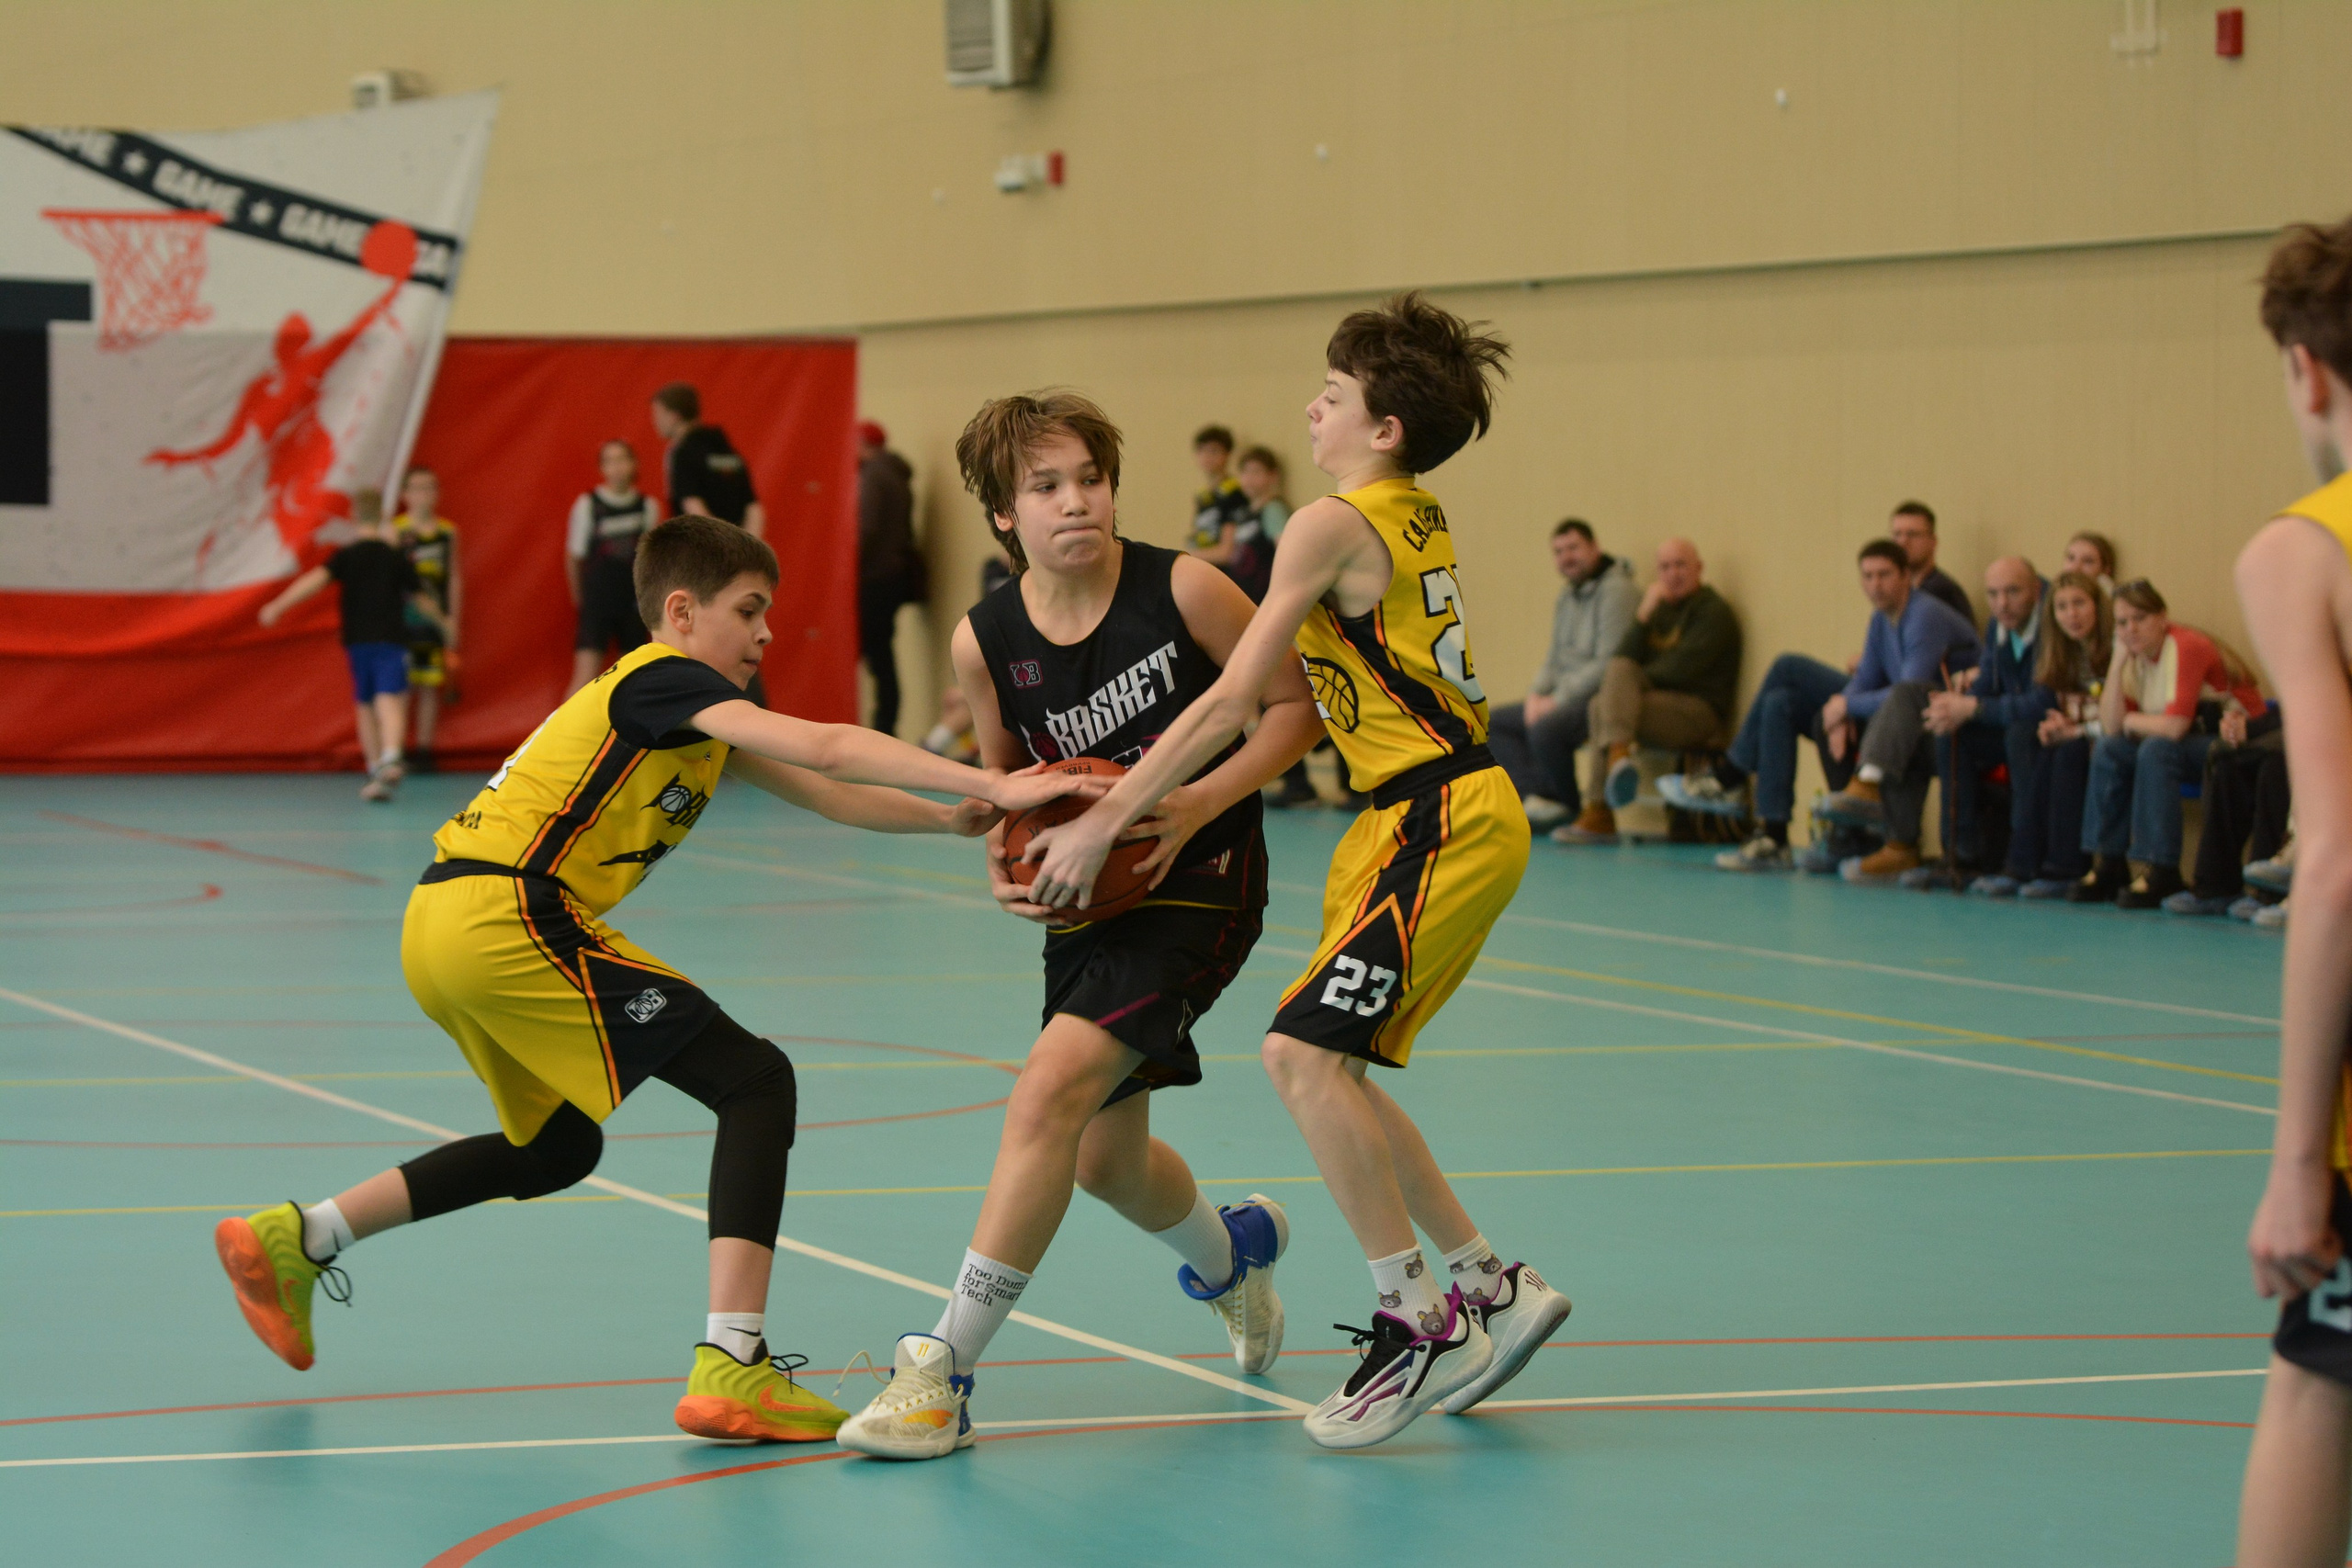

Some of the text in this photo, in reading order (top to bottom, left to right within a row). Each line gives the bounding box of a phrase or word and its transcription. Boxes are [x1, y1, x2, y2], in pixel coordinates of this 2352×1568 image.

[1319, 954, 1397, 1017] 23
[964, 1272, 984, 1288] for
[968, 1263, 992, 1280] Too
[961, 1283, 992, 1306] Tech
